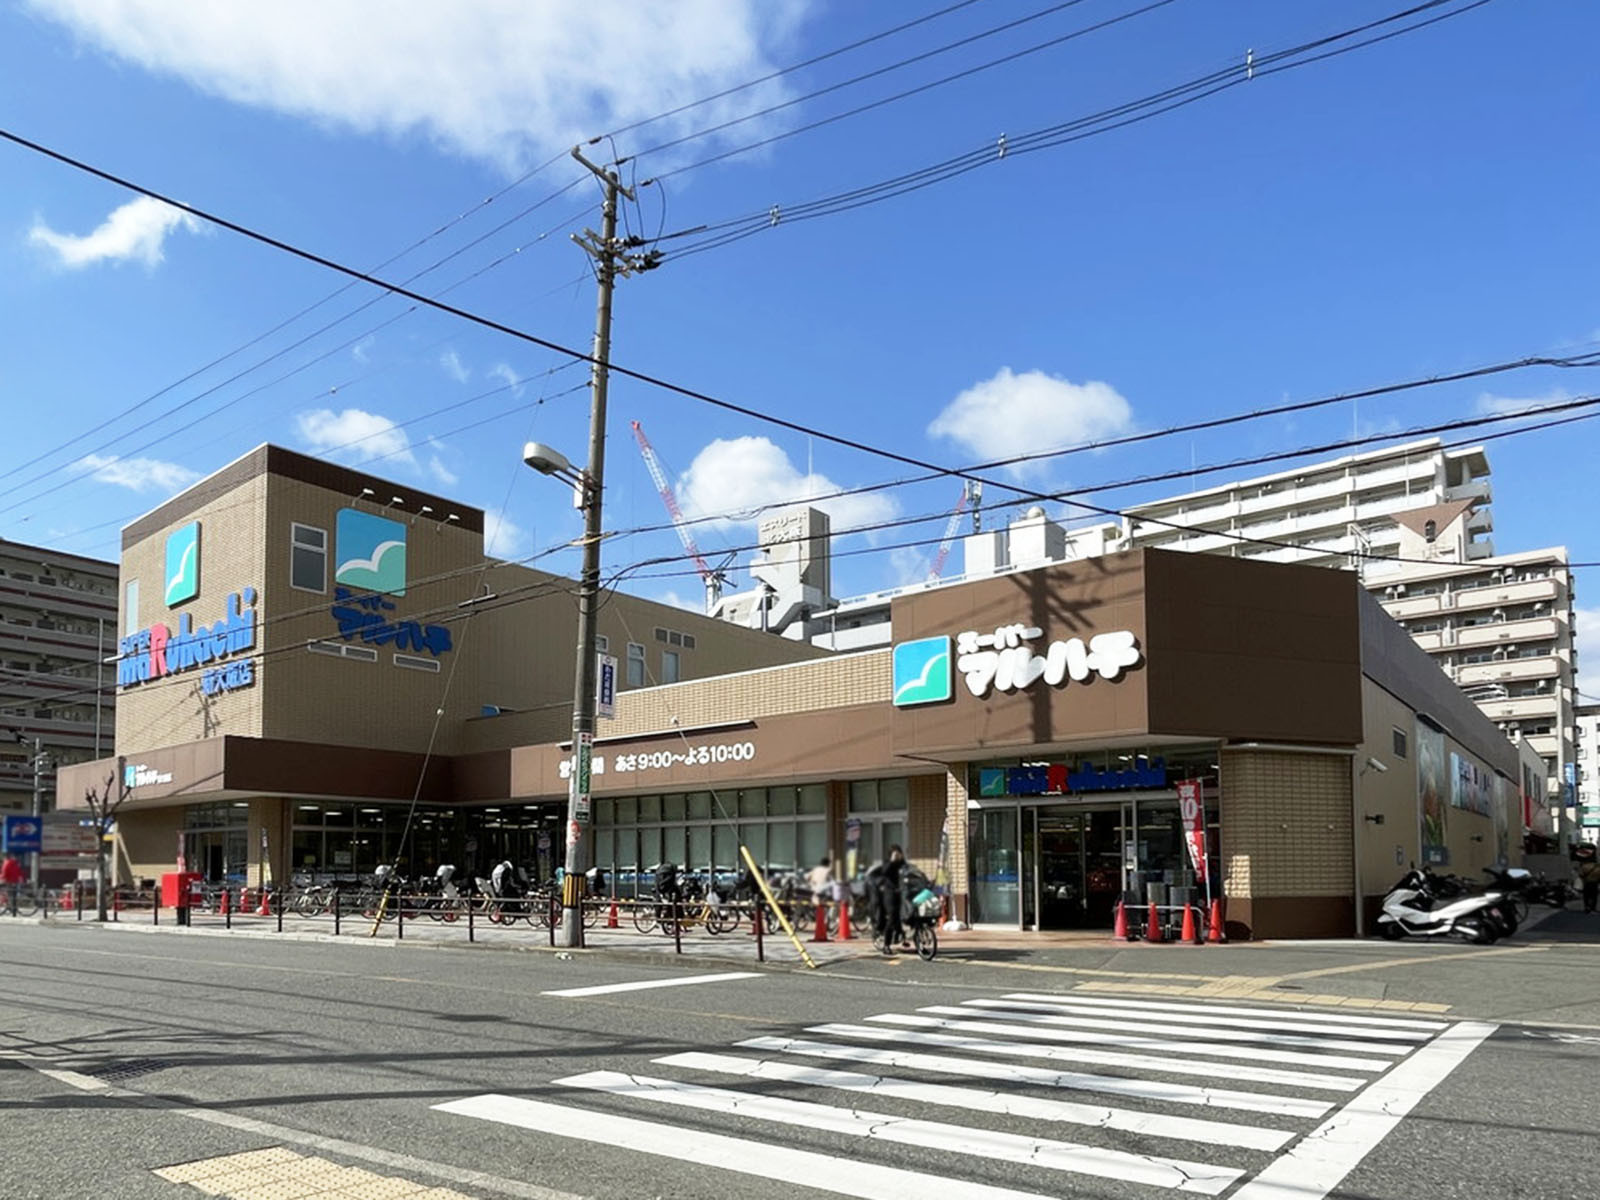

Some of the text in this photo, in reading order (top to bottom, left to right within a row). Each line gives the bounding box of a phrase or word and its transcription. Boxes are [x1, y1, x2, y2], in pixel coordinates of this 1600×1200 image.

[957, 623, 1043, 655] スーパー
[957, 630, 1142, 697] マルハチ
